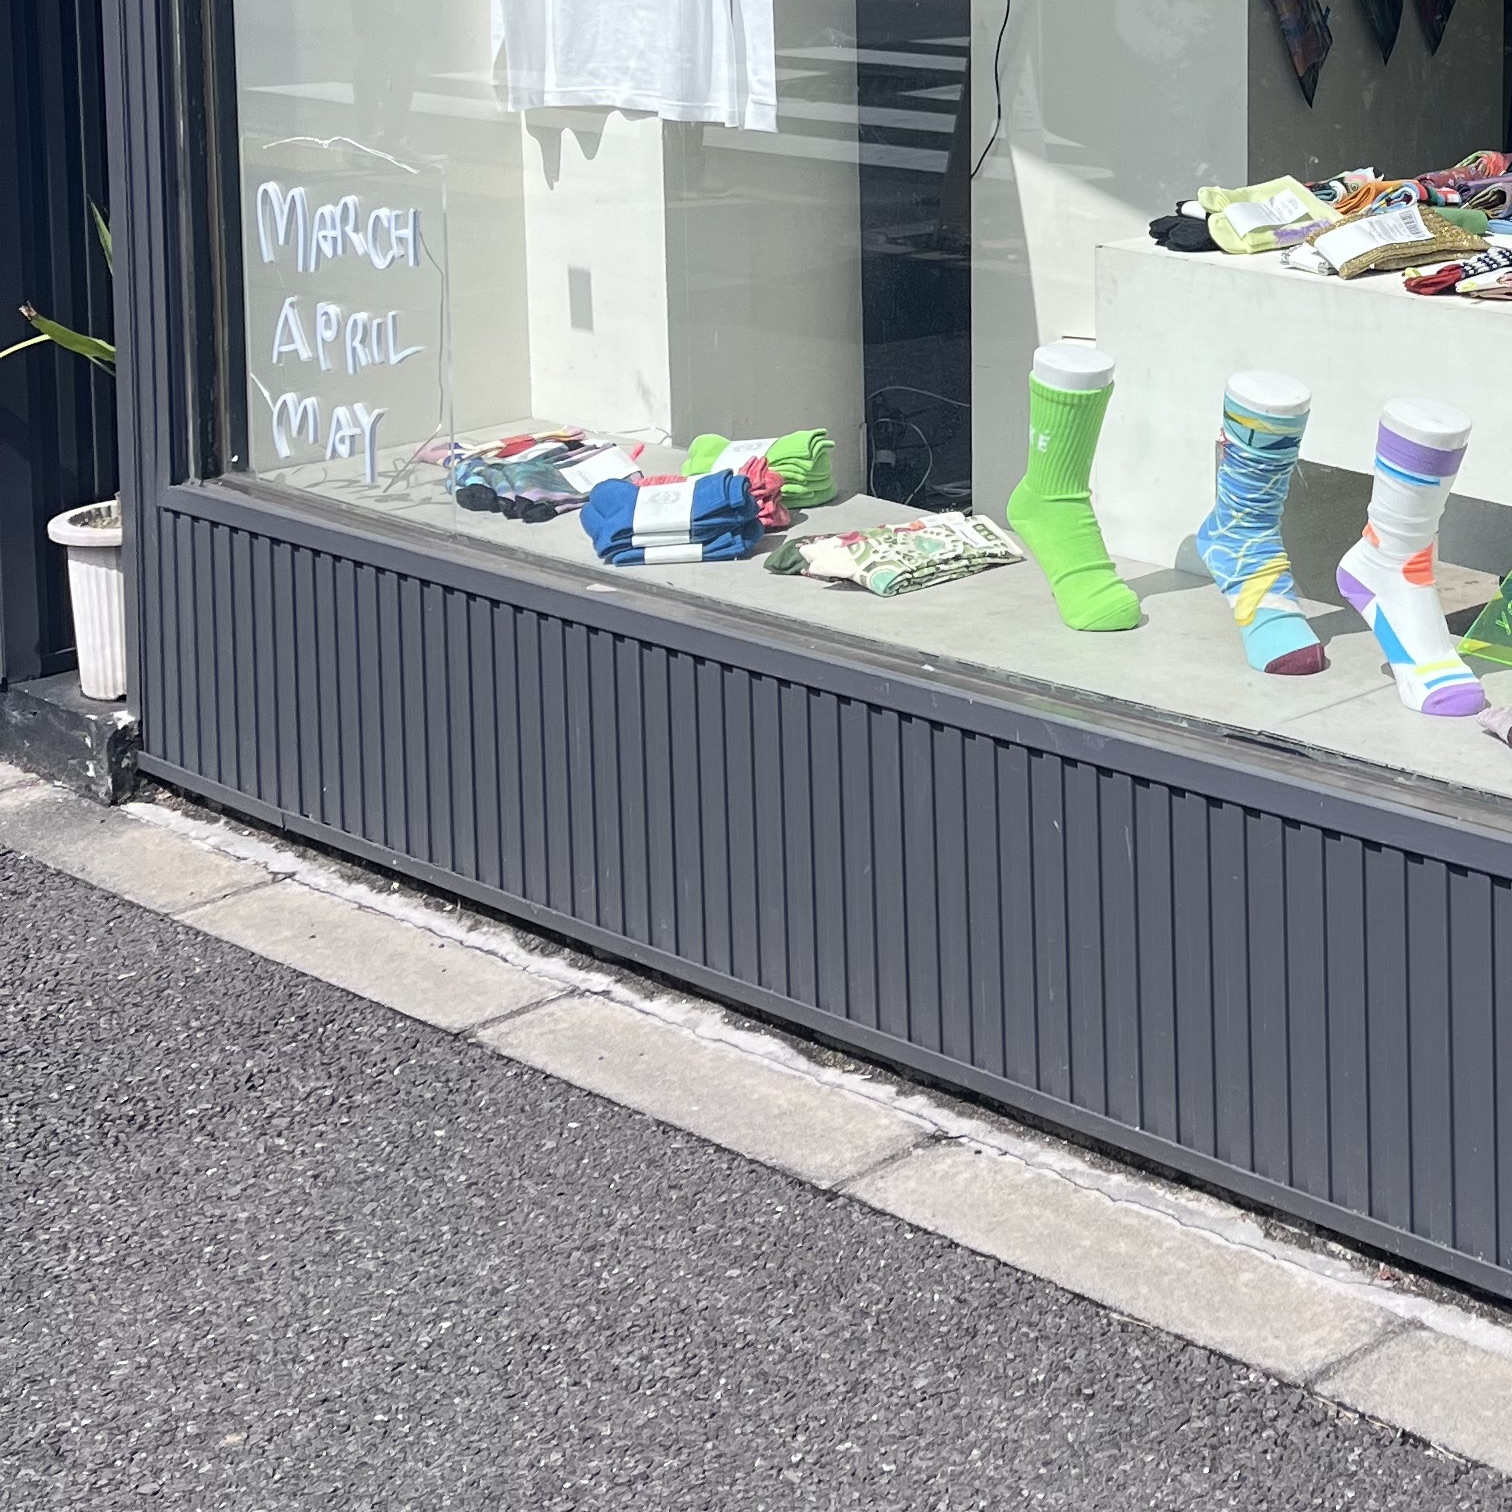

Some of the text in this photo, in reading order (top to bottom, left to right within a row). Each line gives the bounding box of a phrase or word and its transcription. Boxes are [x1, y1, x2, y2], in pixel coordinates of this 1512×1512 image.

[256, 180, 422, 273] MARCH
[271, 295, 425, 375] APRIL
[271, 391, 390, 485] MAY
